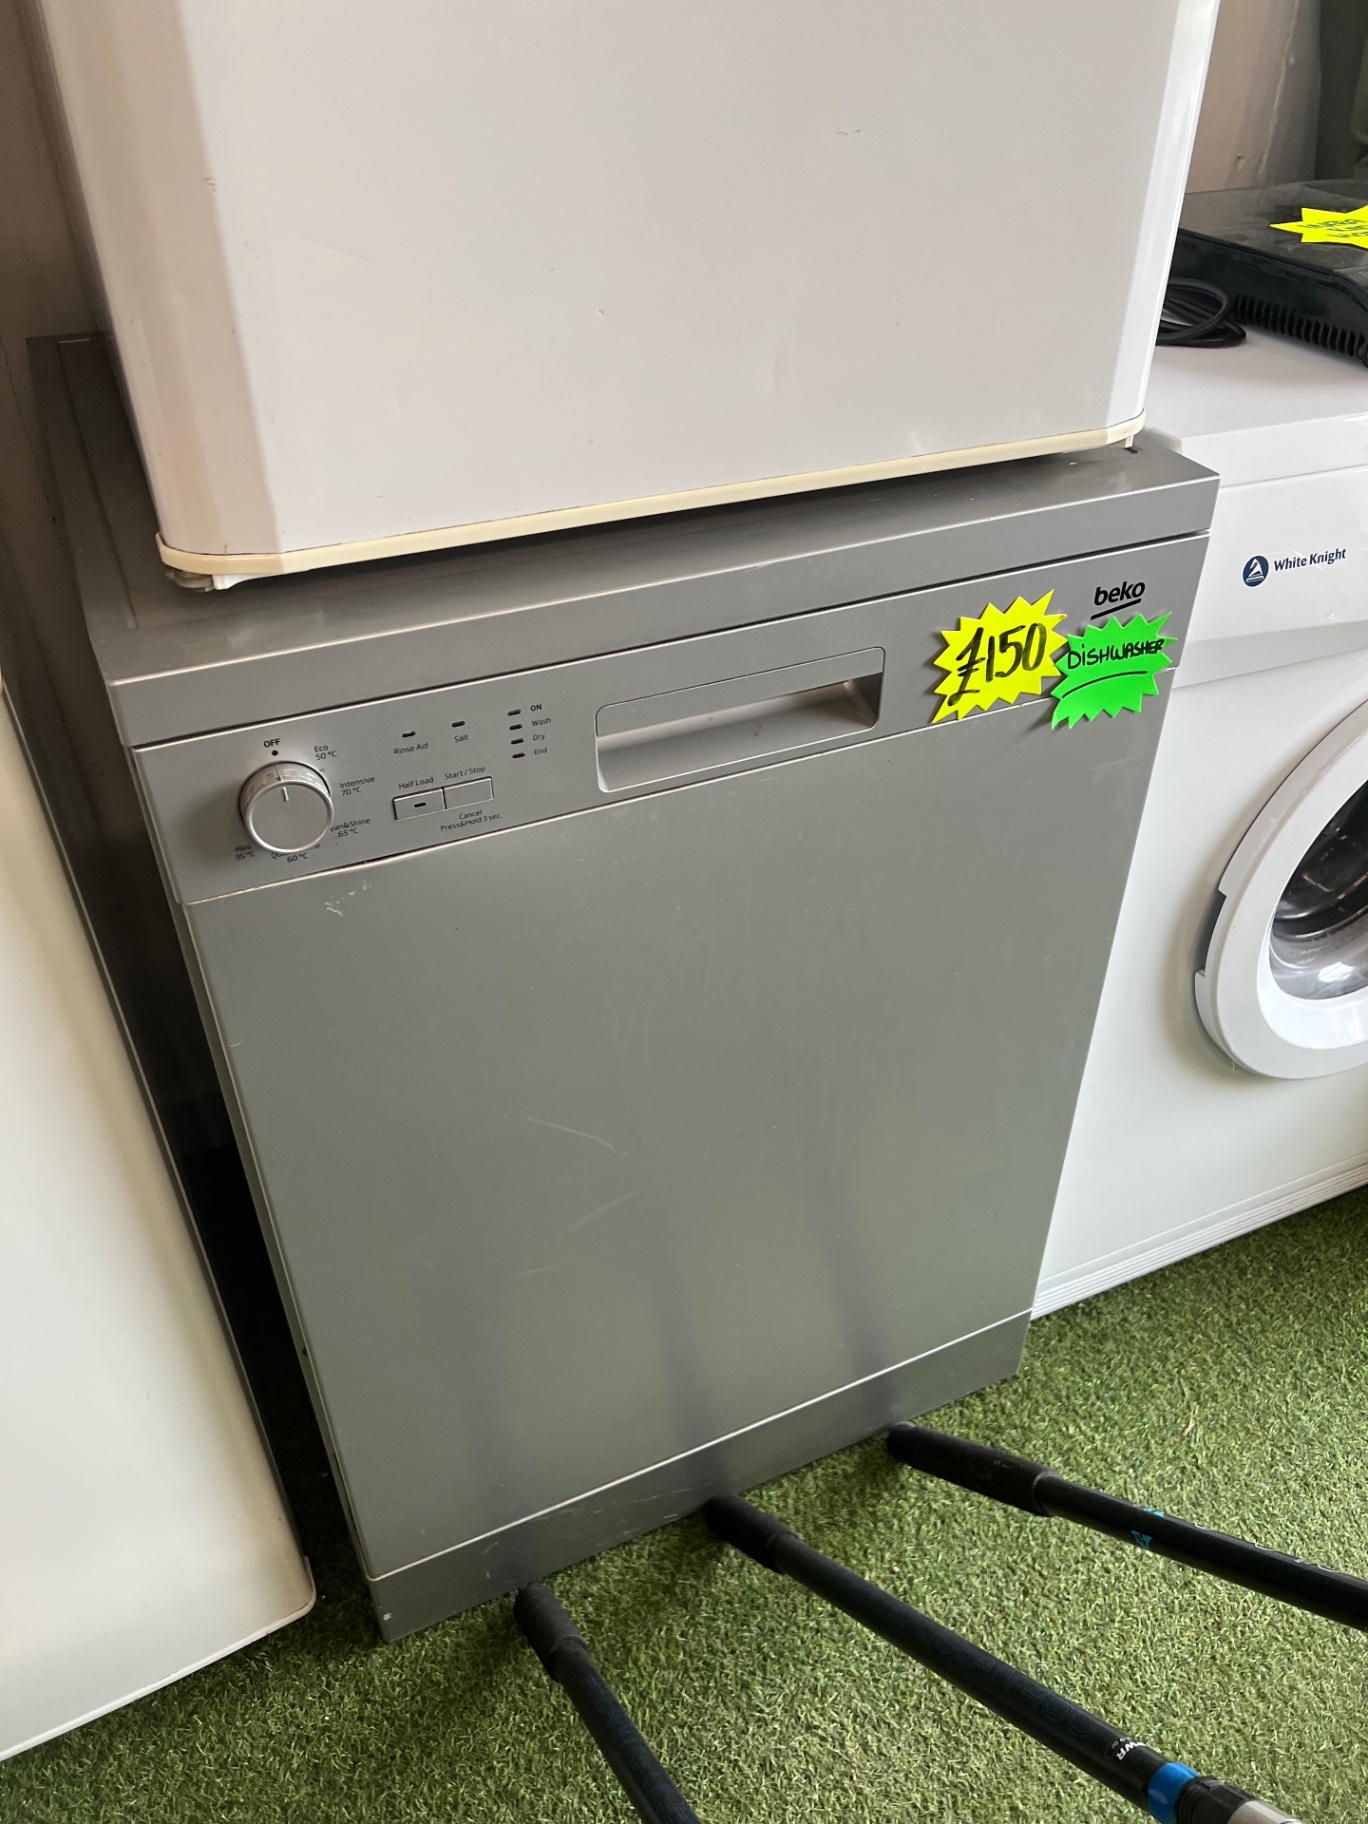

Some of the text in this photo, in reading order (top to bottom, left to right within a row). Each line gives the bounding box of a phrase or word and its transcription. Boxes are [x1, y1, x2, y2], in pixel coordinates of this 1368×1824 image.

[1273, 548, 1347, 572] White Knight
[1093, 581, 1146, 606] beko
[947, 622, 1047, 707] £150
[530, 703, 542, 712] ON
[531, 717, 551, 727] Wash
[263, 738, 281, 748] OFF
[454, 734, 469, 743] Salt
[314, 745, 329, 753] Eco
[394, 742, 429, 755] Rinse Aid
[534, 746, 547, 756] End
[315, 750, 337, 761] 50 °C
[444, 770, 464, 780] Start
[468, 766, 486, 775] Stop
[339, 776, 376, 789] Intensive
[398, 777, 434, 790] Half Load
[341, 788, 352, 796] 70
[459, 810, 483, 820] Cancel
[330, 818, 371, 832] ean&Shine
[440, 817, 482, 831] Press&Hold
[483, 815, 488, 823] 3
[337, 829, 349, 838] 65
[235, 852, 246, 861] 35
[286, 852, 308, 863] 60 °C
